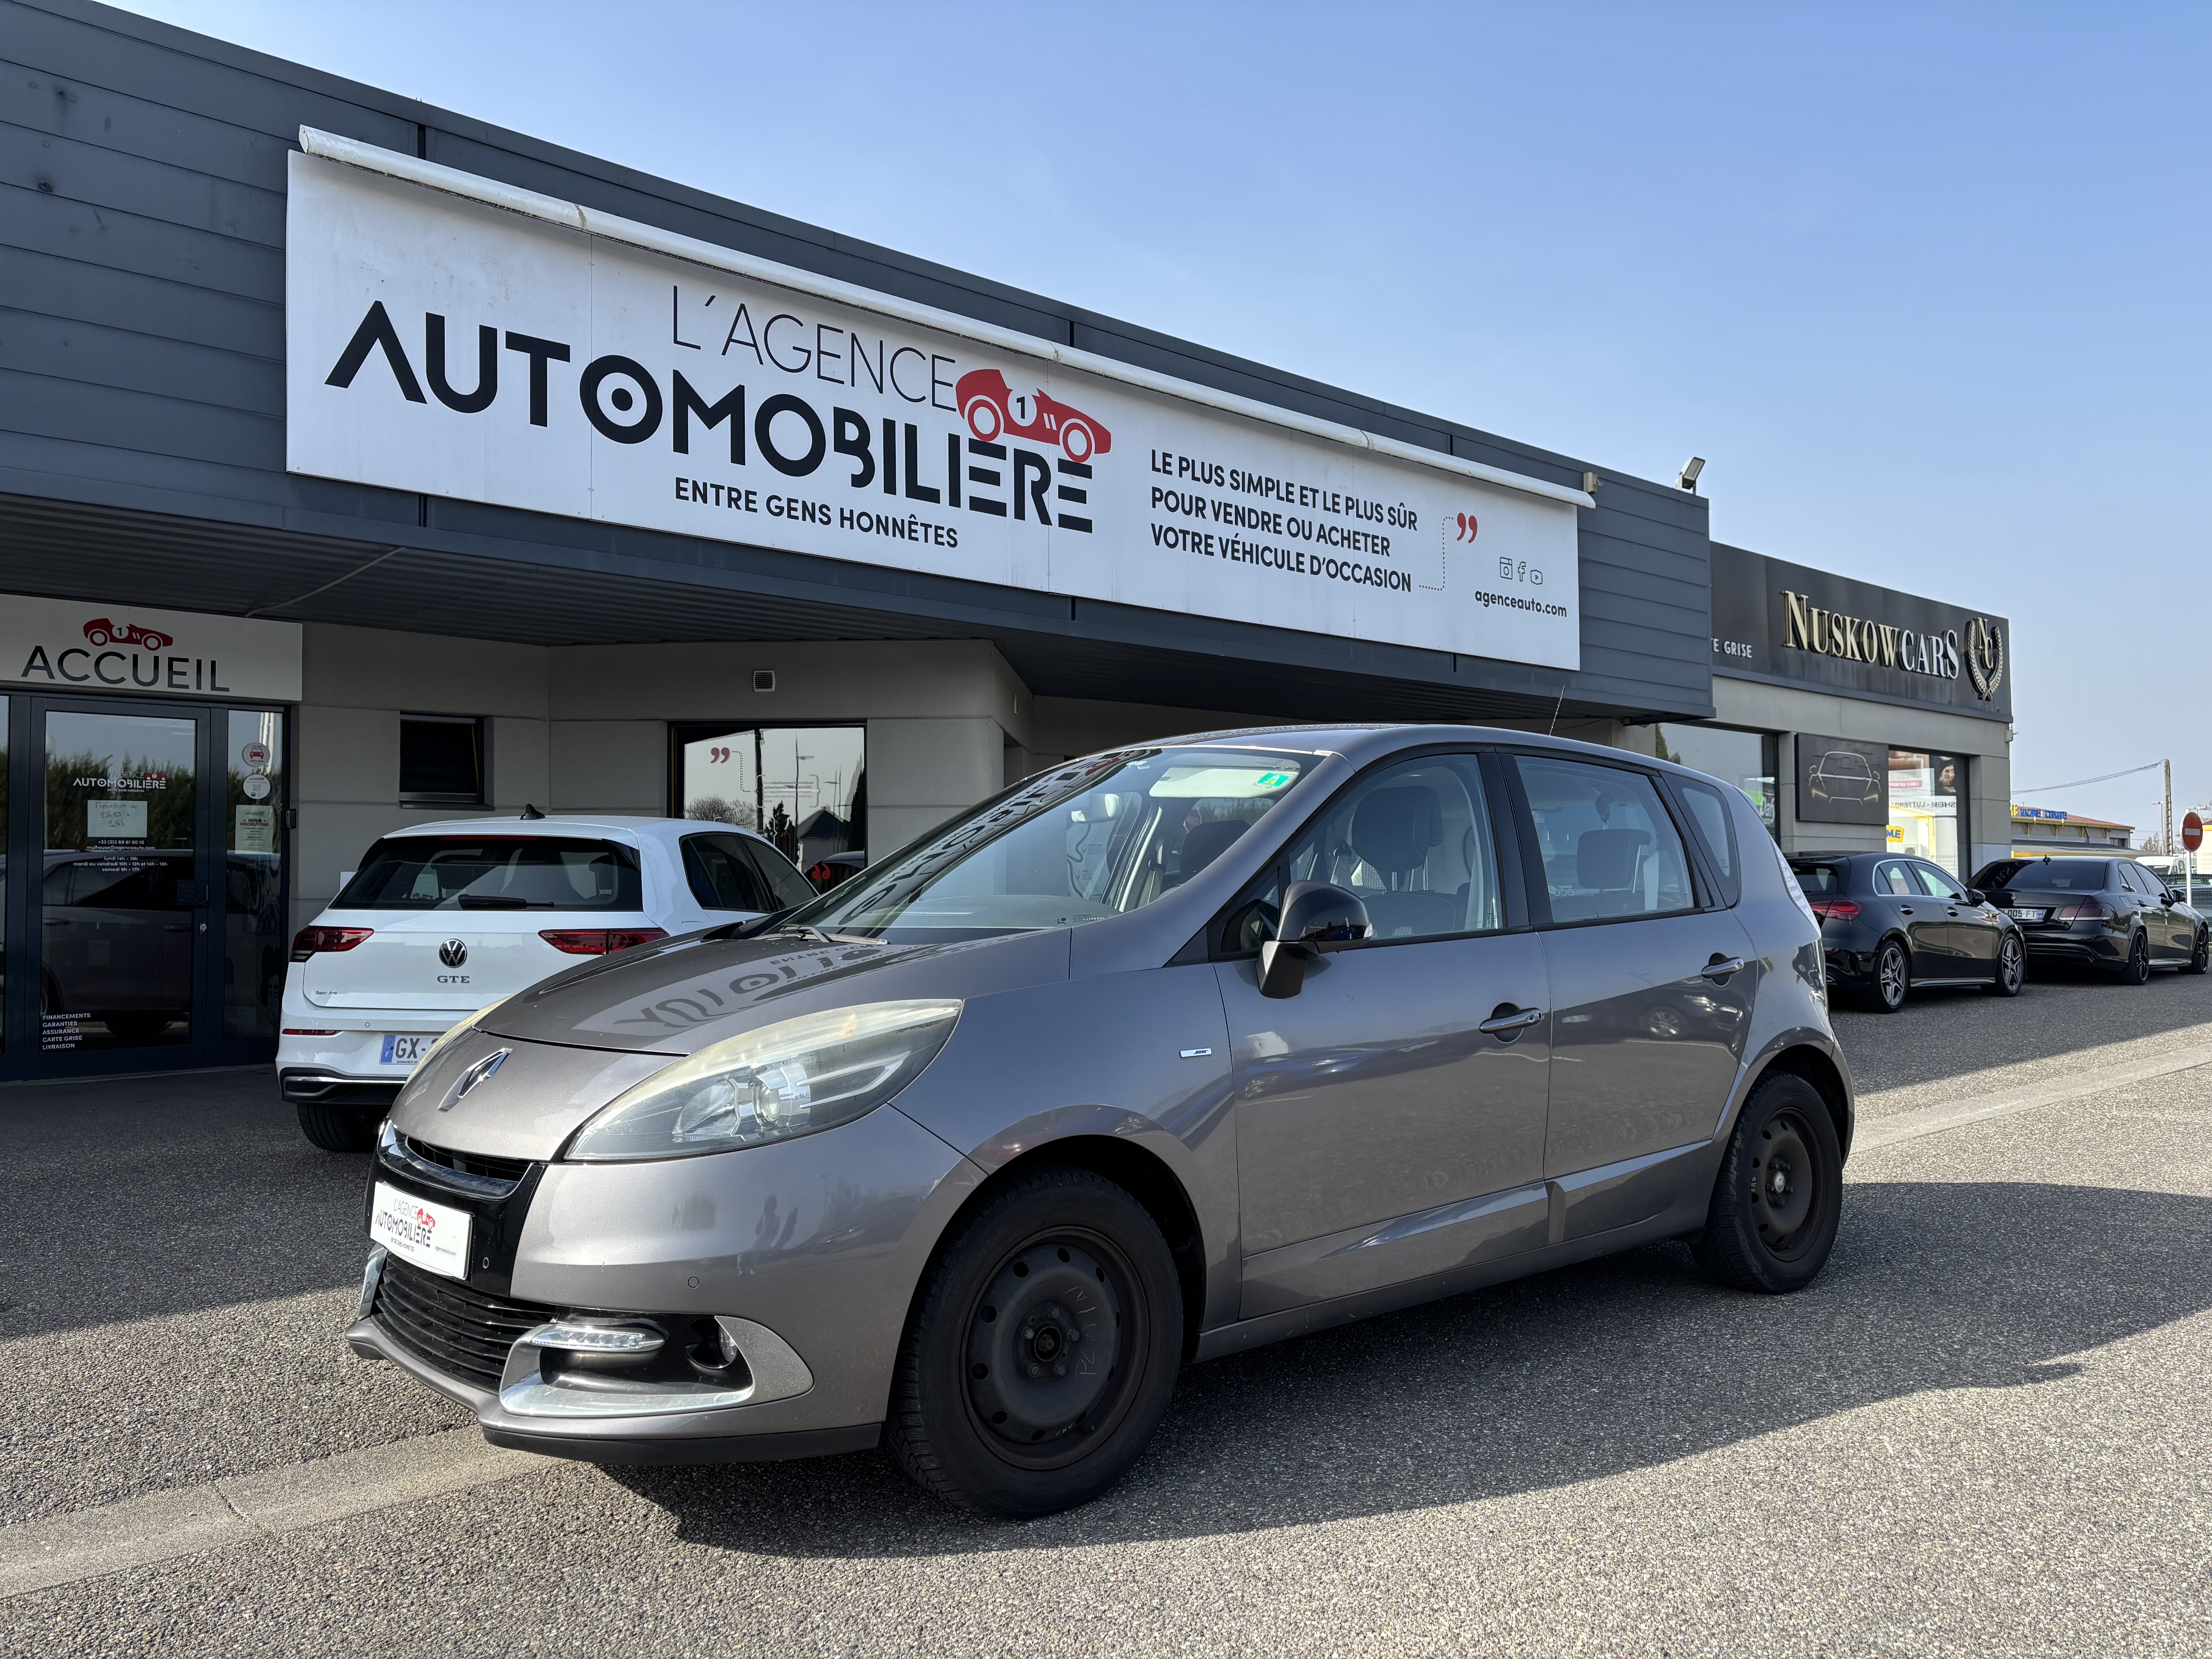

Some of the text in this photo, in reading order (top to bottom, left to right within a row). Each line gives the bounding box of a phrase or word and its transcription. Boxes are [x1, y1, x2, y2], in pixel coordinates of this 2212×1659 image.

[673, 285, 957, 411] L'AGENCE
[675, 477, 958, 548] ENTRE GENS HONNÊTES
[1152, 449, 1417, 531] LE PLUS SIMPLE ET LE PLUS SÛR
[1152, 486, 1390, 557] POUR VENDRE OU ACHETER
[1151, 523, 1412, 592] VOTRE VÉHICULE D'OCCASION
[1475, 589, 1567, 618] agenceauto.com
[21, 646, 229, 692] ACCUEIL
[1711, 638, 1752, 658] E GRISE
